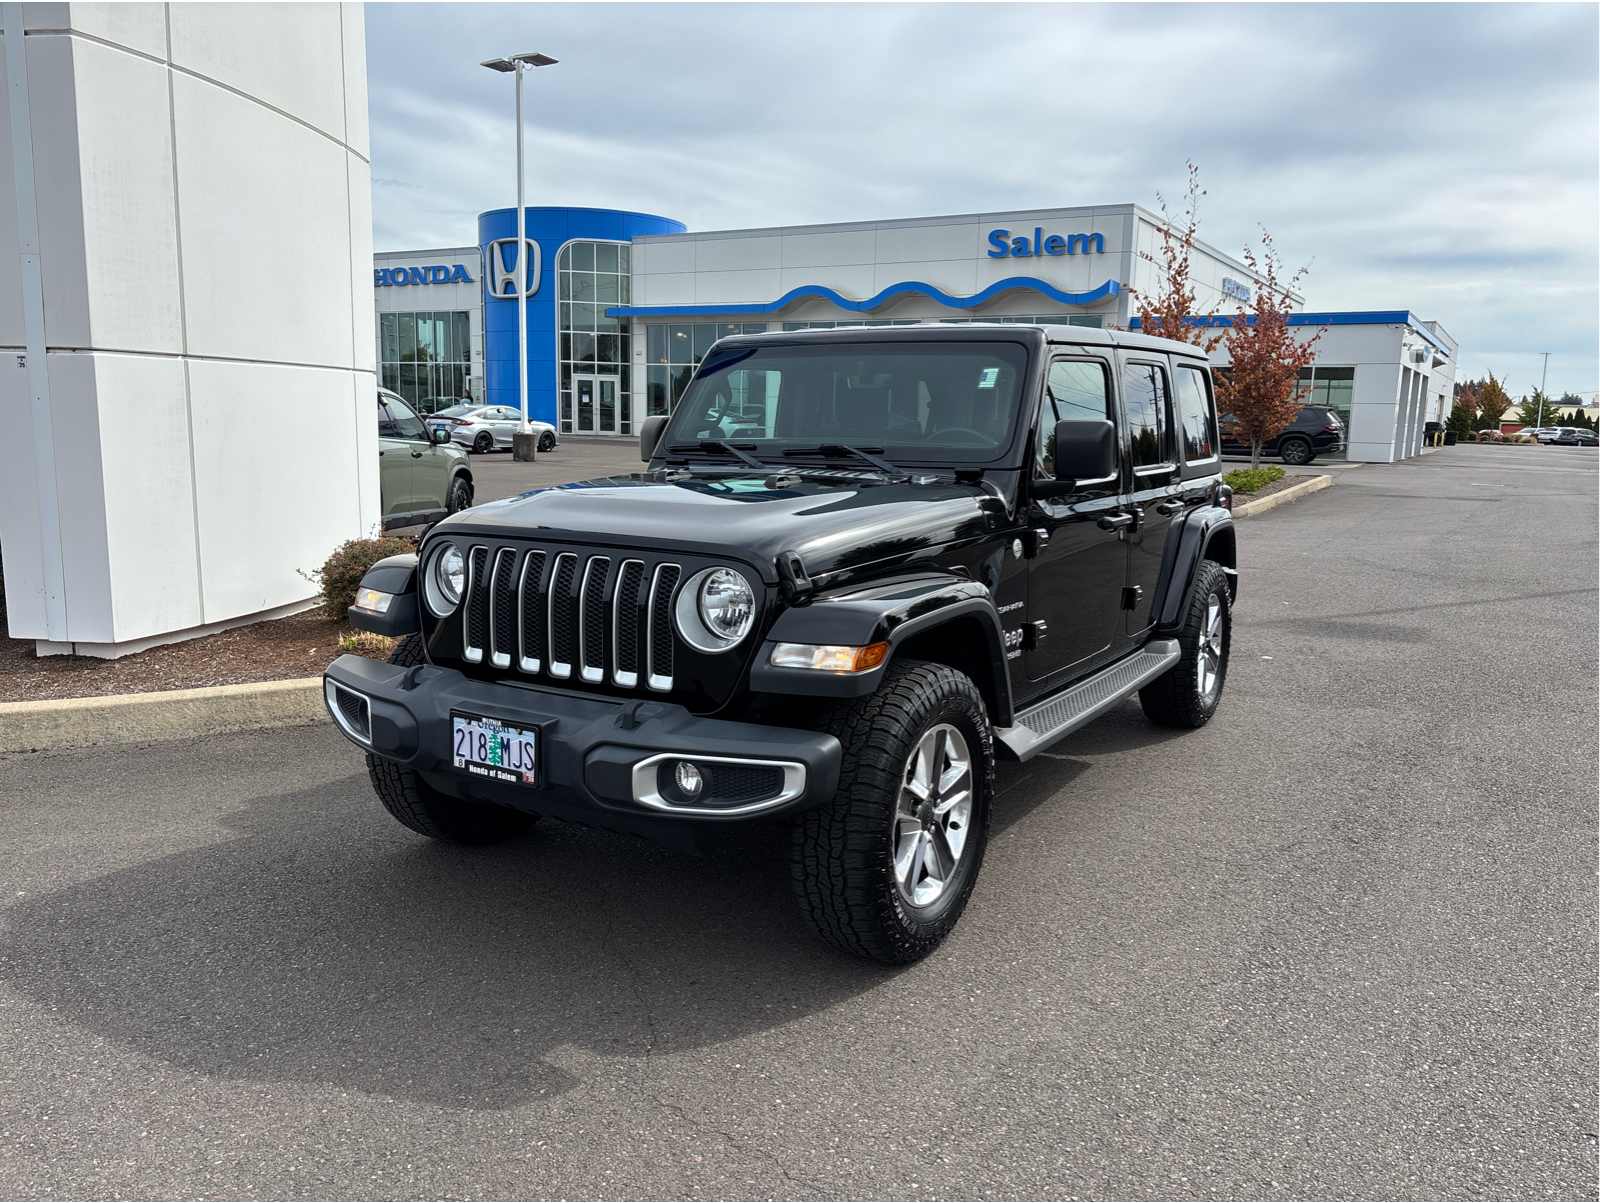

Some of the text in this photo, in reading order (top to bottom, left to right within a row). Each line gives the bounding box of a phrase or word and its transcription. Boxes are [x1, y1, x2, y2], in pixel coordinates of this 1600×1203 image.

[987, 227, 1104, 258] Salem
[374, 264, 474, 287] HONDA
[456, 729, 535, 771] 218 MJS
[469, 765, 488, 776] Honda
[497, 771, 517, 782] Salem
